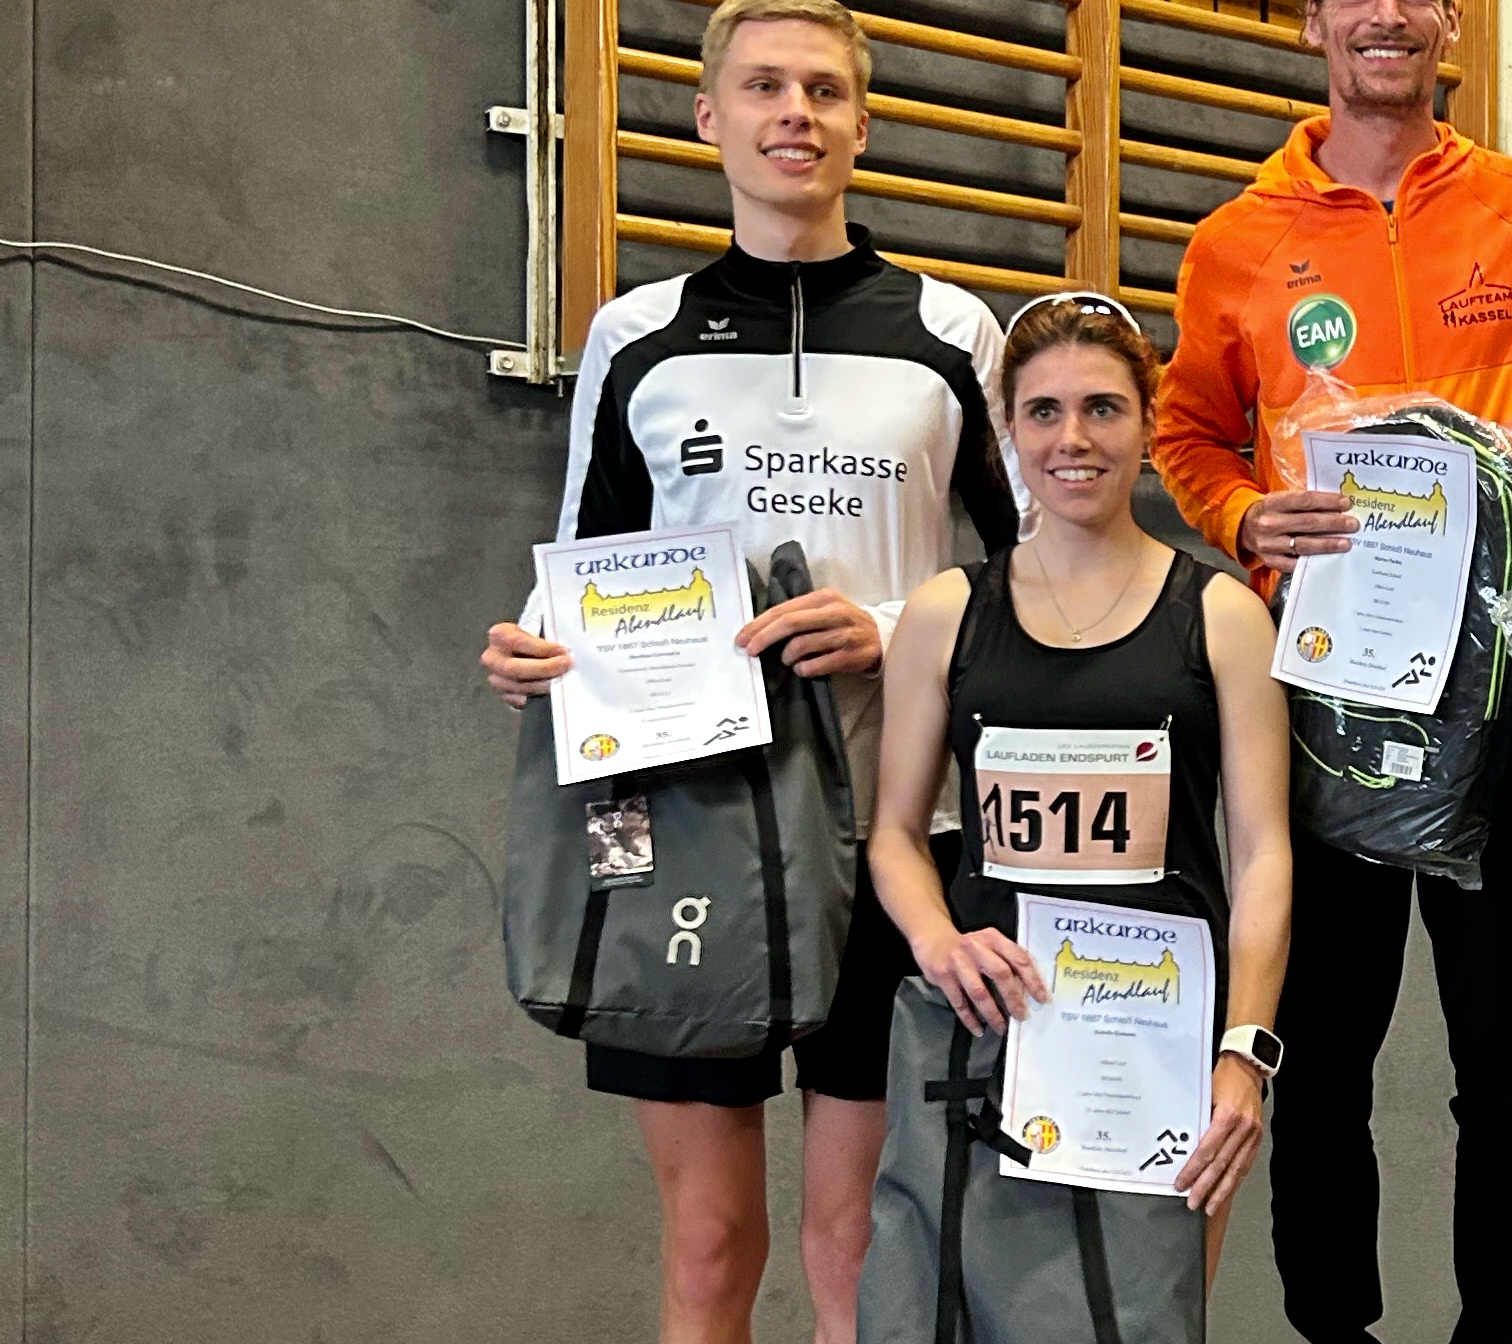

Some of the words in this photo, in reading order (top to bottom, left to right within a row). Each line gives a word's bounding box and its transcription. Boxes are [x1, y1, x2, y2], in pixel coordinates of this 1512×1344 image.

[1287, 274, 1322, 289] erima
[1441, 291, 1512, 313] LAUFTEAM
[1458, 309, 1512, 326] KASSEL
[699, 331, 738, 341] erima
[1296, 316, 1346, 348] EAM
[745, 445, 908, 482] Sparkasse
[747, 486, 863, 517] Geseke
[1363, 509, 1438, 536] Abendlauf
[1404, 546, 1433, 559] Neuhaus
[591, 603, 650, 618] Residenz
[614, 596, 706, 638] Abendlauf
[986, 749, 1056, 763] LAUFLADEN
[1060, 753, 1130, 763] ENDSPURT
[982, 783, 1131, 854] 1514
[1063, 966, 1120, 983] Residenz
[1081, 978, 1171, 1006] Abendlauf
